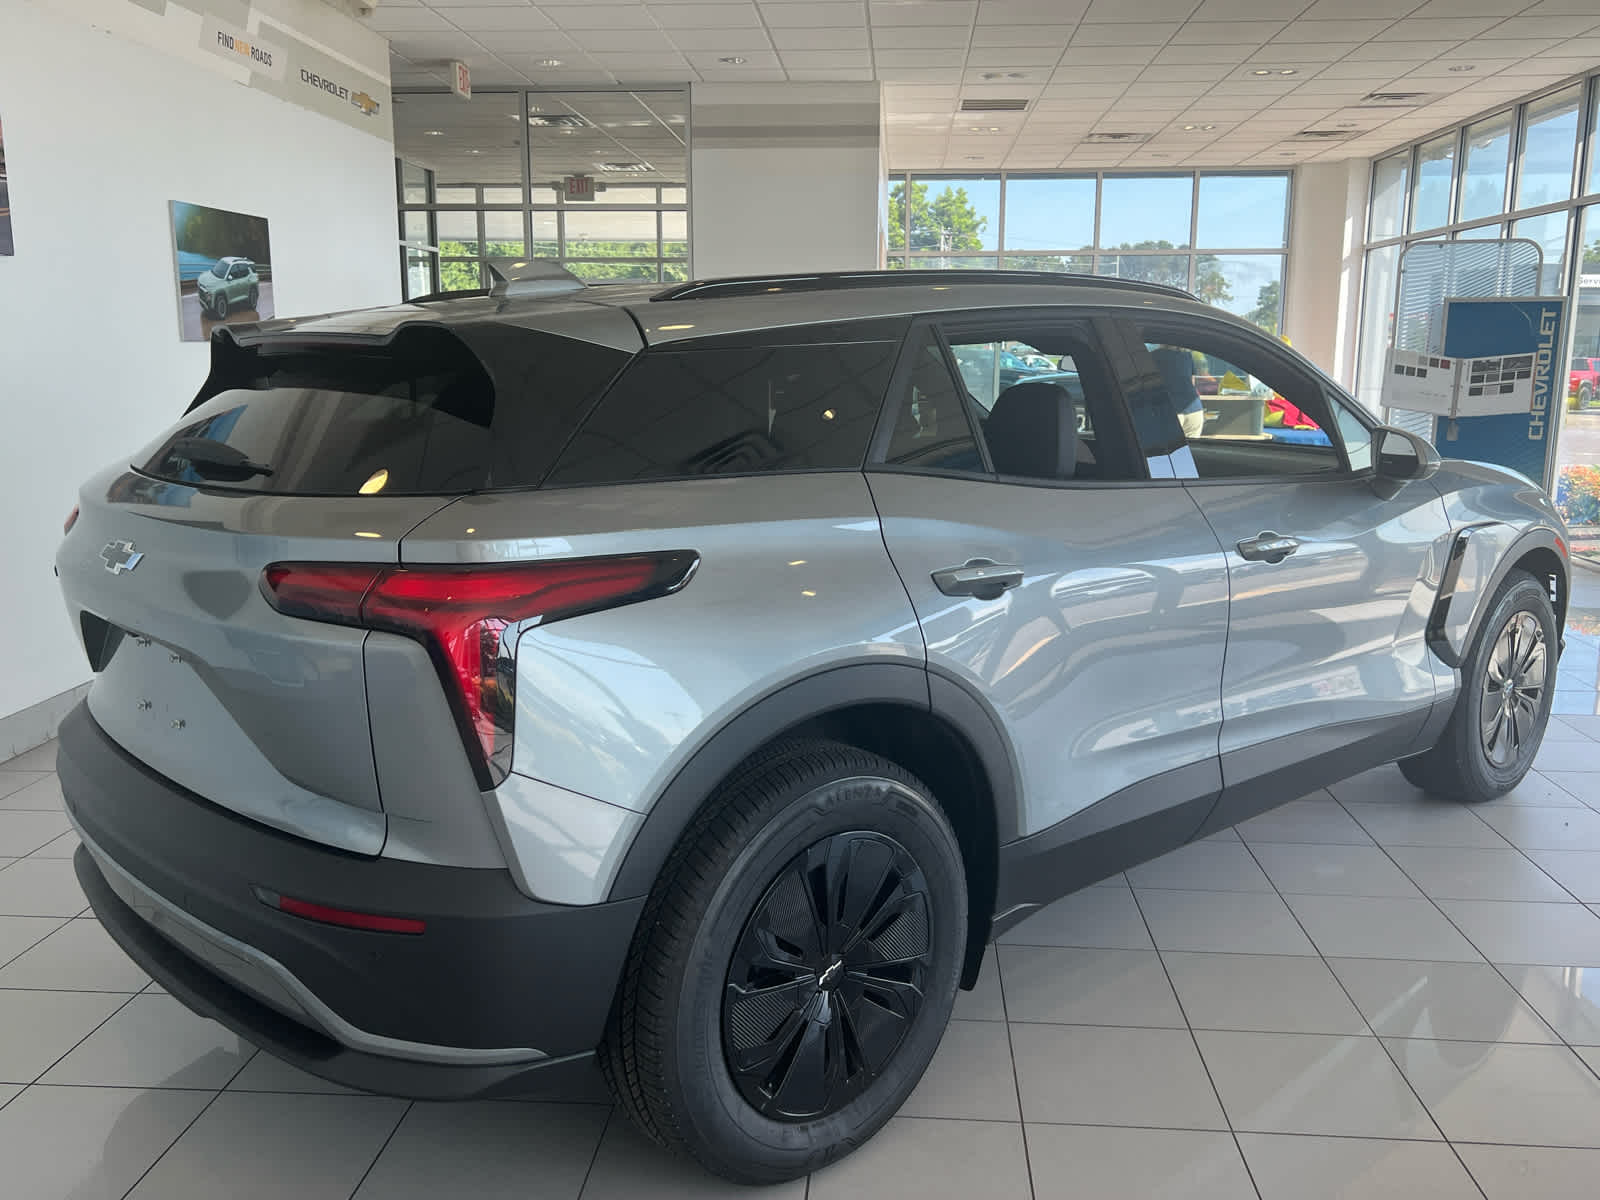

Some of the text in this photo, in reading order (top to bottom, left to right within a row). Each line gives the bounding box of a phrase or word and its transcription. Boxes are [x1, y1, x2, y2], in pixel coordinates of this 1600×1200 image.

[217, 31, 234, 50] FIND
[251, 45, 272, 67] ROADS
[300, 69, 349, 101] CHEVROLET
[1528, 307, 1557, 440] CHEVROLET
